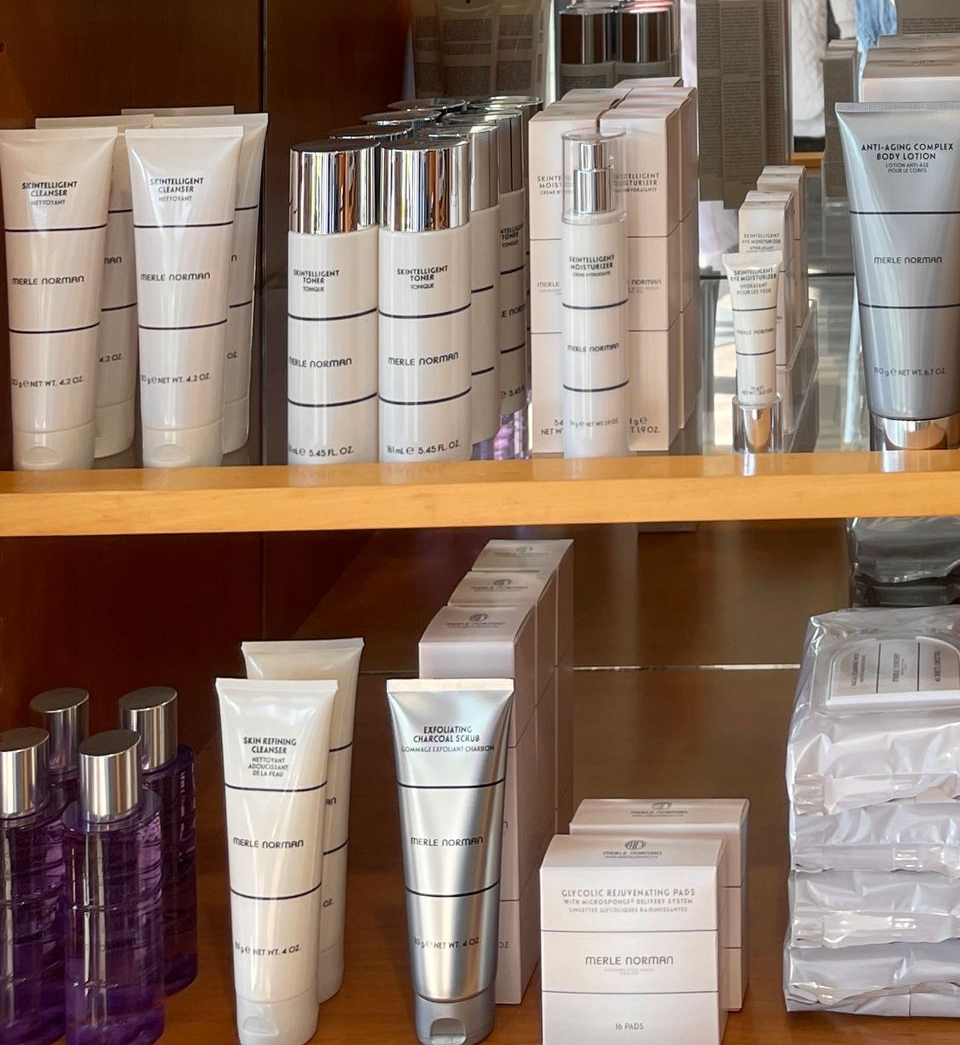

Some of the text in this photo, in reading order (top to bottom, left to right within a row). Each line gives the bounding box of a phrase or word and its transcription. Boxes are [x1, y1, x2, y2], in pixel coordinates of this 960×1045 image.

[861, 143, 954, 151] ANTI-AGING COMPLEX
[876, 152, 936, 161] BODY LOTION
[22, 181, 78, 189] SKINTELLIGENT
[158, 185, 194, 193] CLEANSER
[30, 189, 68, 197] CLEANSER
[874, 256, 943, 264] MERLE NORMAN
[397, 265, 448, 275] SKINTELLIGENT
[570, 262, 614, 270] MOISTURIZER
[140, 272, 211, 281] MERLE NORMAN
[293, 269, 340, 277] SKINTELLIGENT
[12, 275, 84, 285] MERLE NORMAN
[302, 276, 325, 284] TONER
[410, 274, 434, 282] TONER
[309, 357, 352, 368] NORMAN
[387, 351, 459, 366] MERLE NORMAN
[418, 445, 436, 455] 5.45
[423, 726, 472, 734] EXFOLIATING
[243, 737, 297, 746] SKIN REFINING
[413, 734, 480, 743] CHARCOAL SCRUB
[251, 746, 287, 754] CLEANSER
[233, 837, 304, 849] MERLE NORMAN
[410, 836, 483, 847] MERLE NORMAN
[561, 888, 695, 897] GLYCOLIC REJUVENATING PADS
[585, 955, 674, 965] MERLE NORMAN
